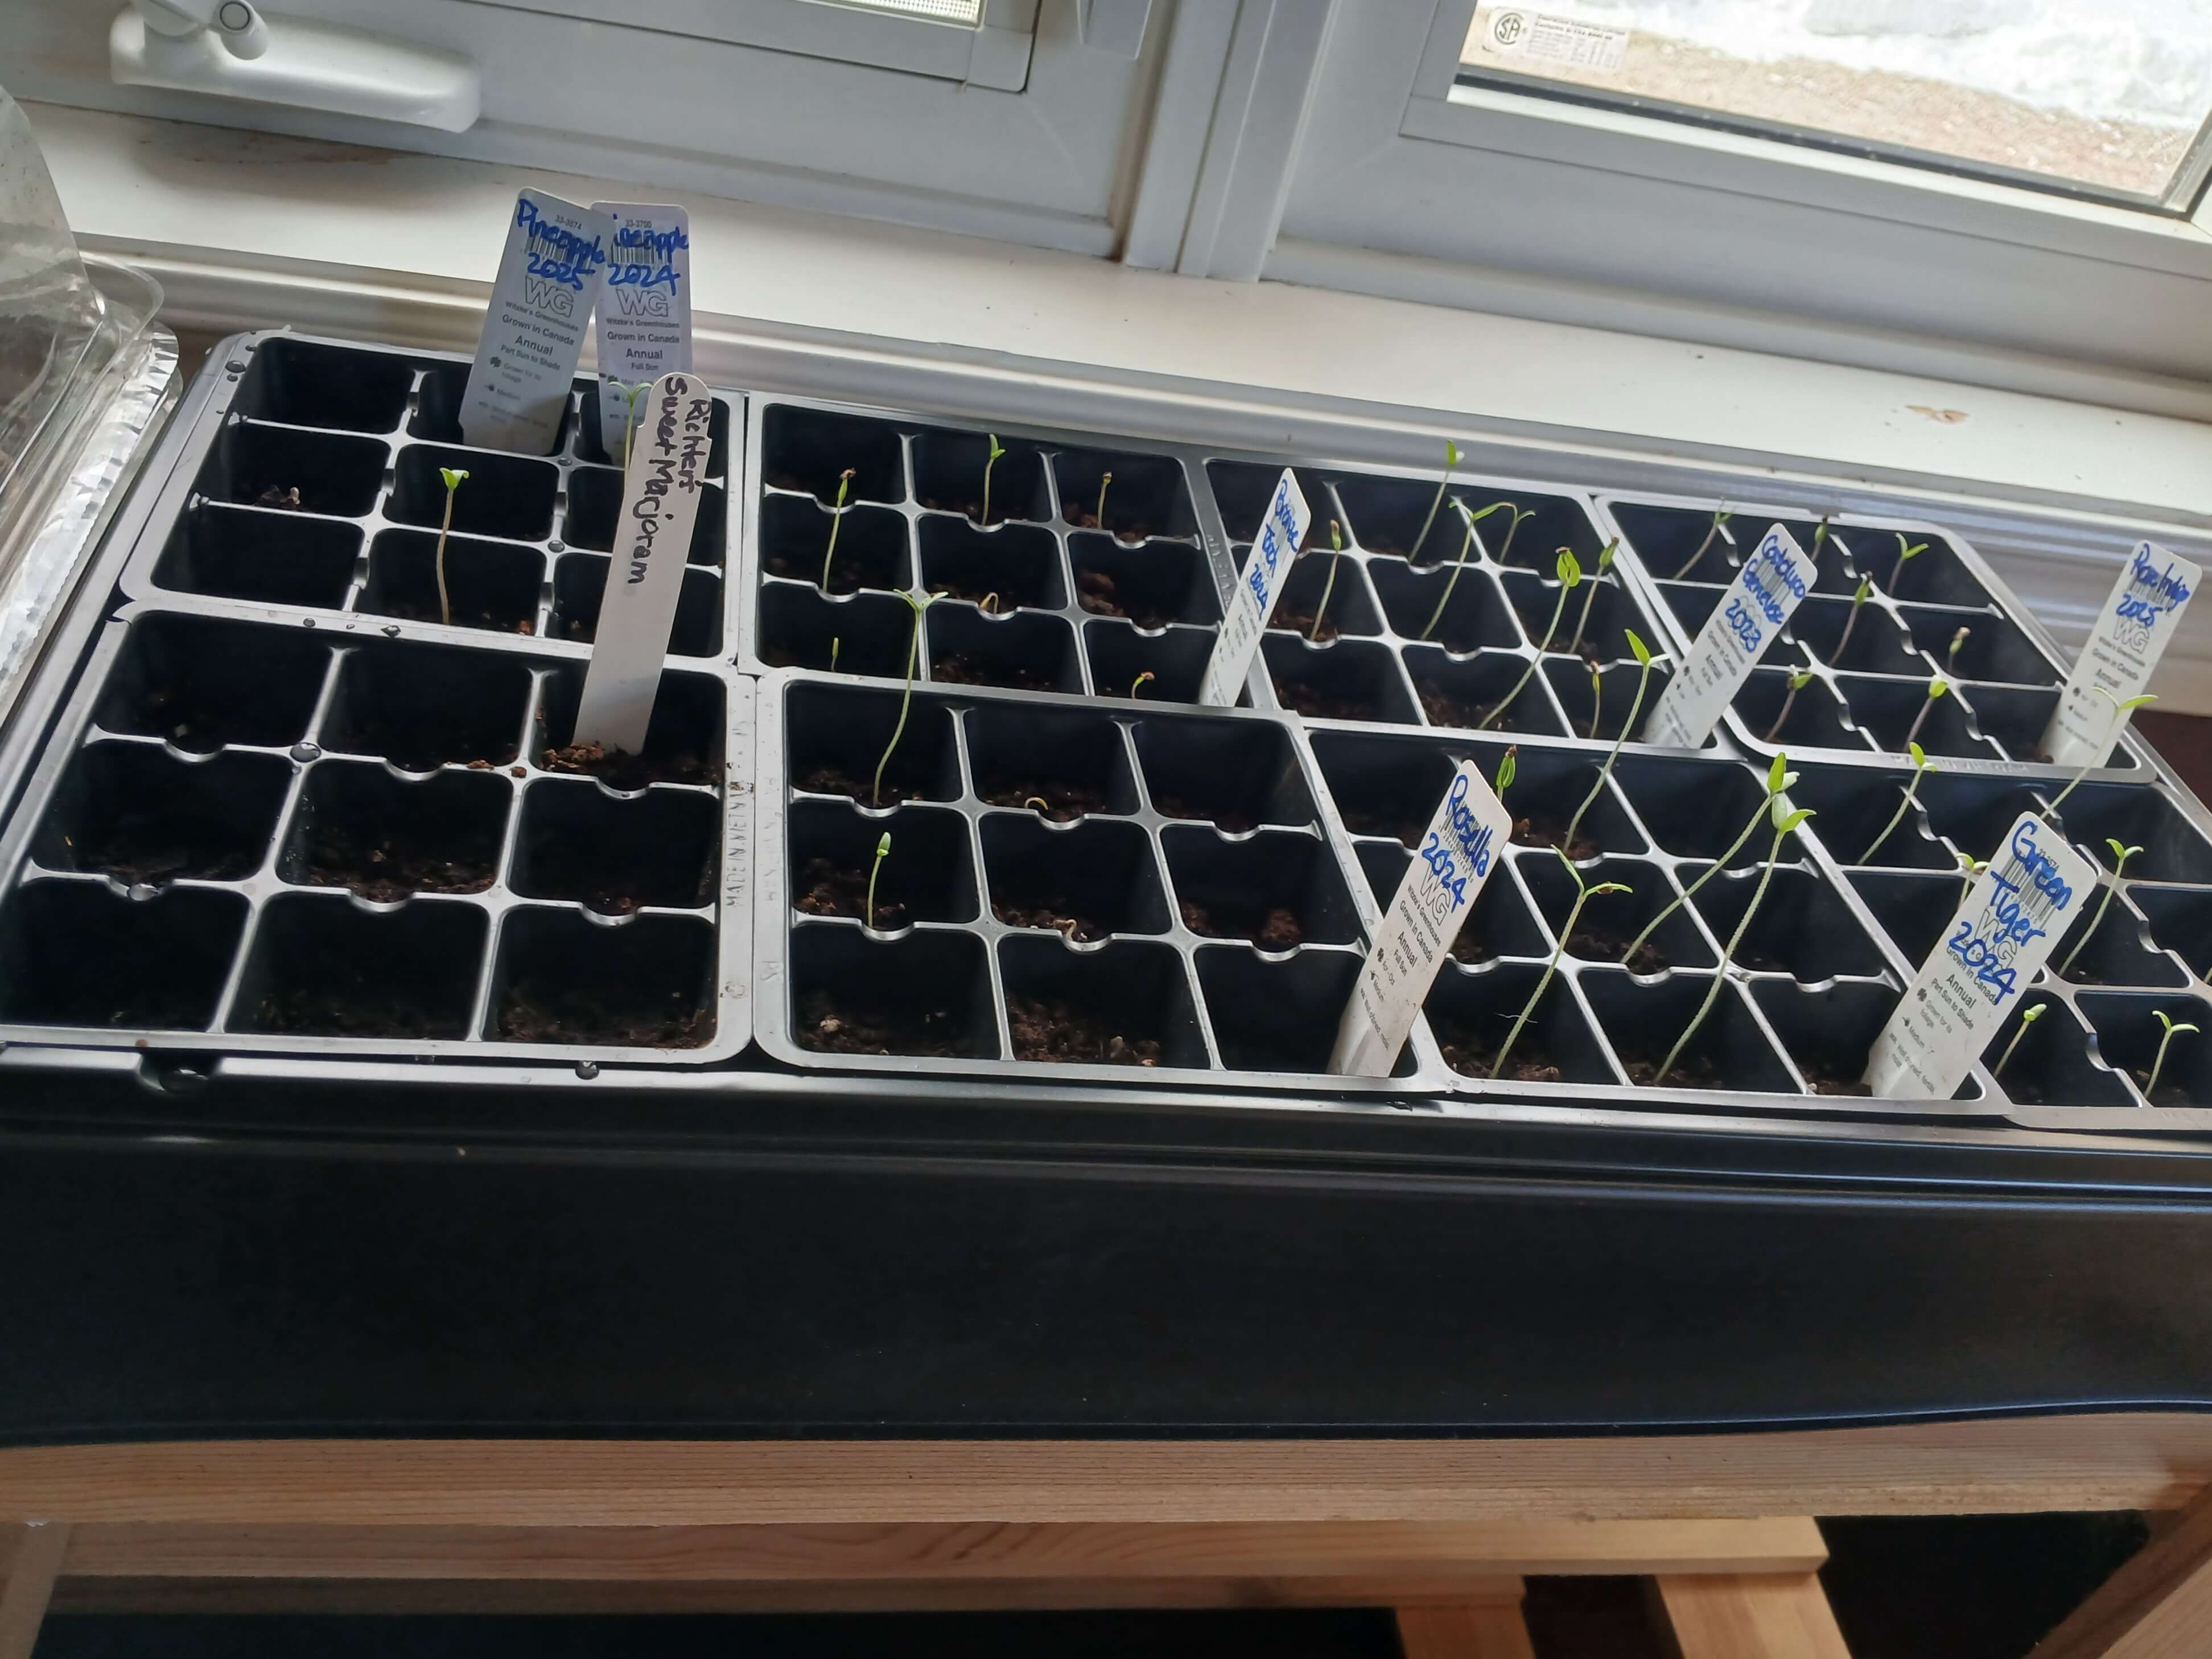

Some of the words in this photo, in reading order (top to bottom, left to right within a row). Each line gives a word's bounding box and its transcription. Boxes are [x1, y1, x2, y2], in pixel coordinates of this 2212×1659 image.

[527, 252, 596, 291] 2025
[607, 264, 681, 296] 2024
[525, 276, 575, 318] WG
[616, 289, 669, 317] WG
[502, 315, 531, 331] Grown
[532, 323, 541, 334] in
[542, 326, 575, 346] Canada
[515, 335, 554, 356] Annual
[607, 331, 636, 341] Grown
[637, 332, 646, 342] in
[647, 334, 680, 344] Canada
[625, 348, 663, 360] Annual
[655, 377, 688, 456] Sweet
[1725, 598, 1762, 653] 2023
[2113, 616, 2151, 654] WG
[1422, 832, 1467, 914] 2024
[2012, 821, 2073, 911] Green
[1419, 907, 1441, 948] Greenhouses
[1990, 870, 2046, 948] Tiger
[1397, 931, 1416, 968] Annual
[1399, 900, 1412, 922] Grown
[1411, 919, 1418, 931] in
[1416, 929, 1434, 964] Canada
[1399, 960, 1408, 977] Sun
[1946, 945, 1967, 971] Grown
[1966, 966, 1974, 979] in
[1949, 921, 2017, 1006] 2024
[1931, 978, 1944, 994] Part
[1941, 990, 1953, 1005] Sun
[1951, 1001, 1958, 1011] to
[1956, 1008, 1974, 1030] Shade
[1945, 974, 1977, 1009] Annual
